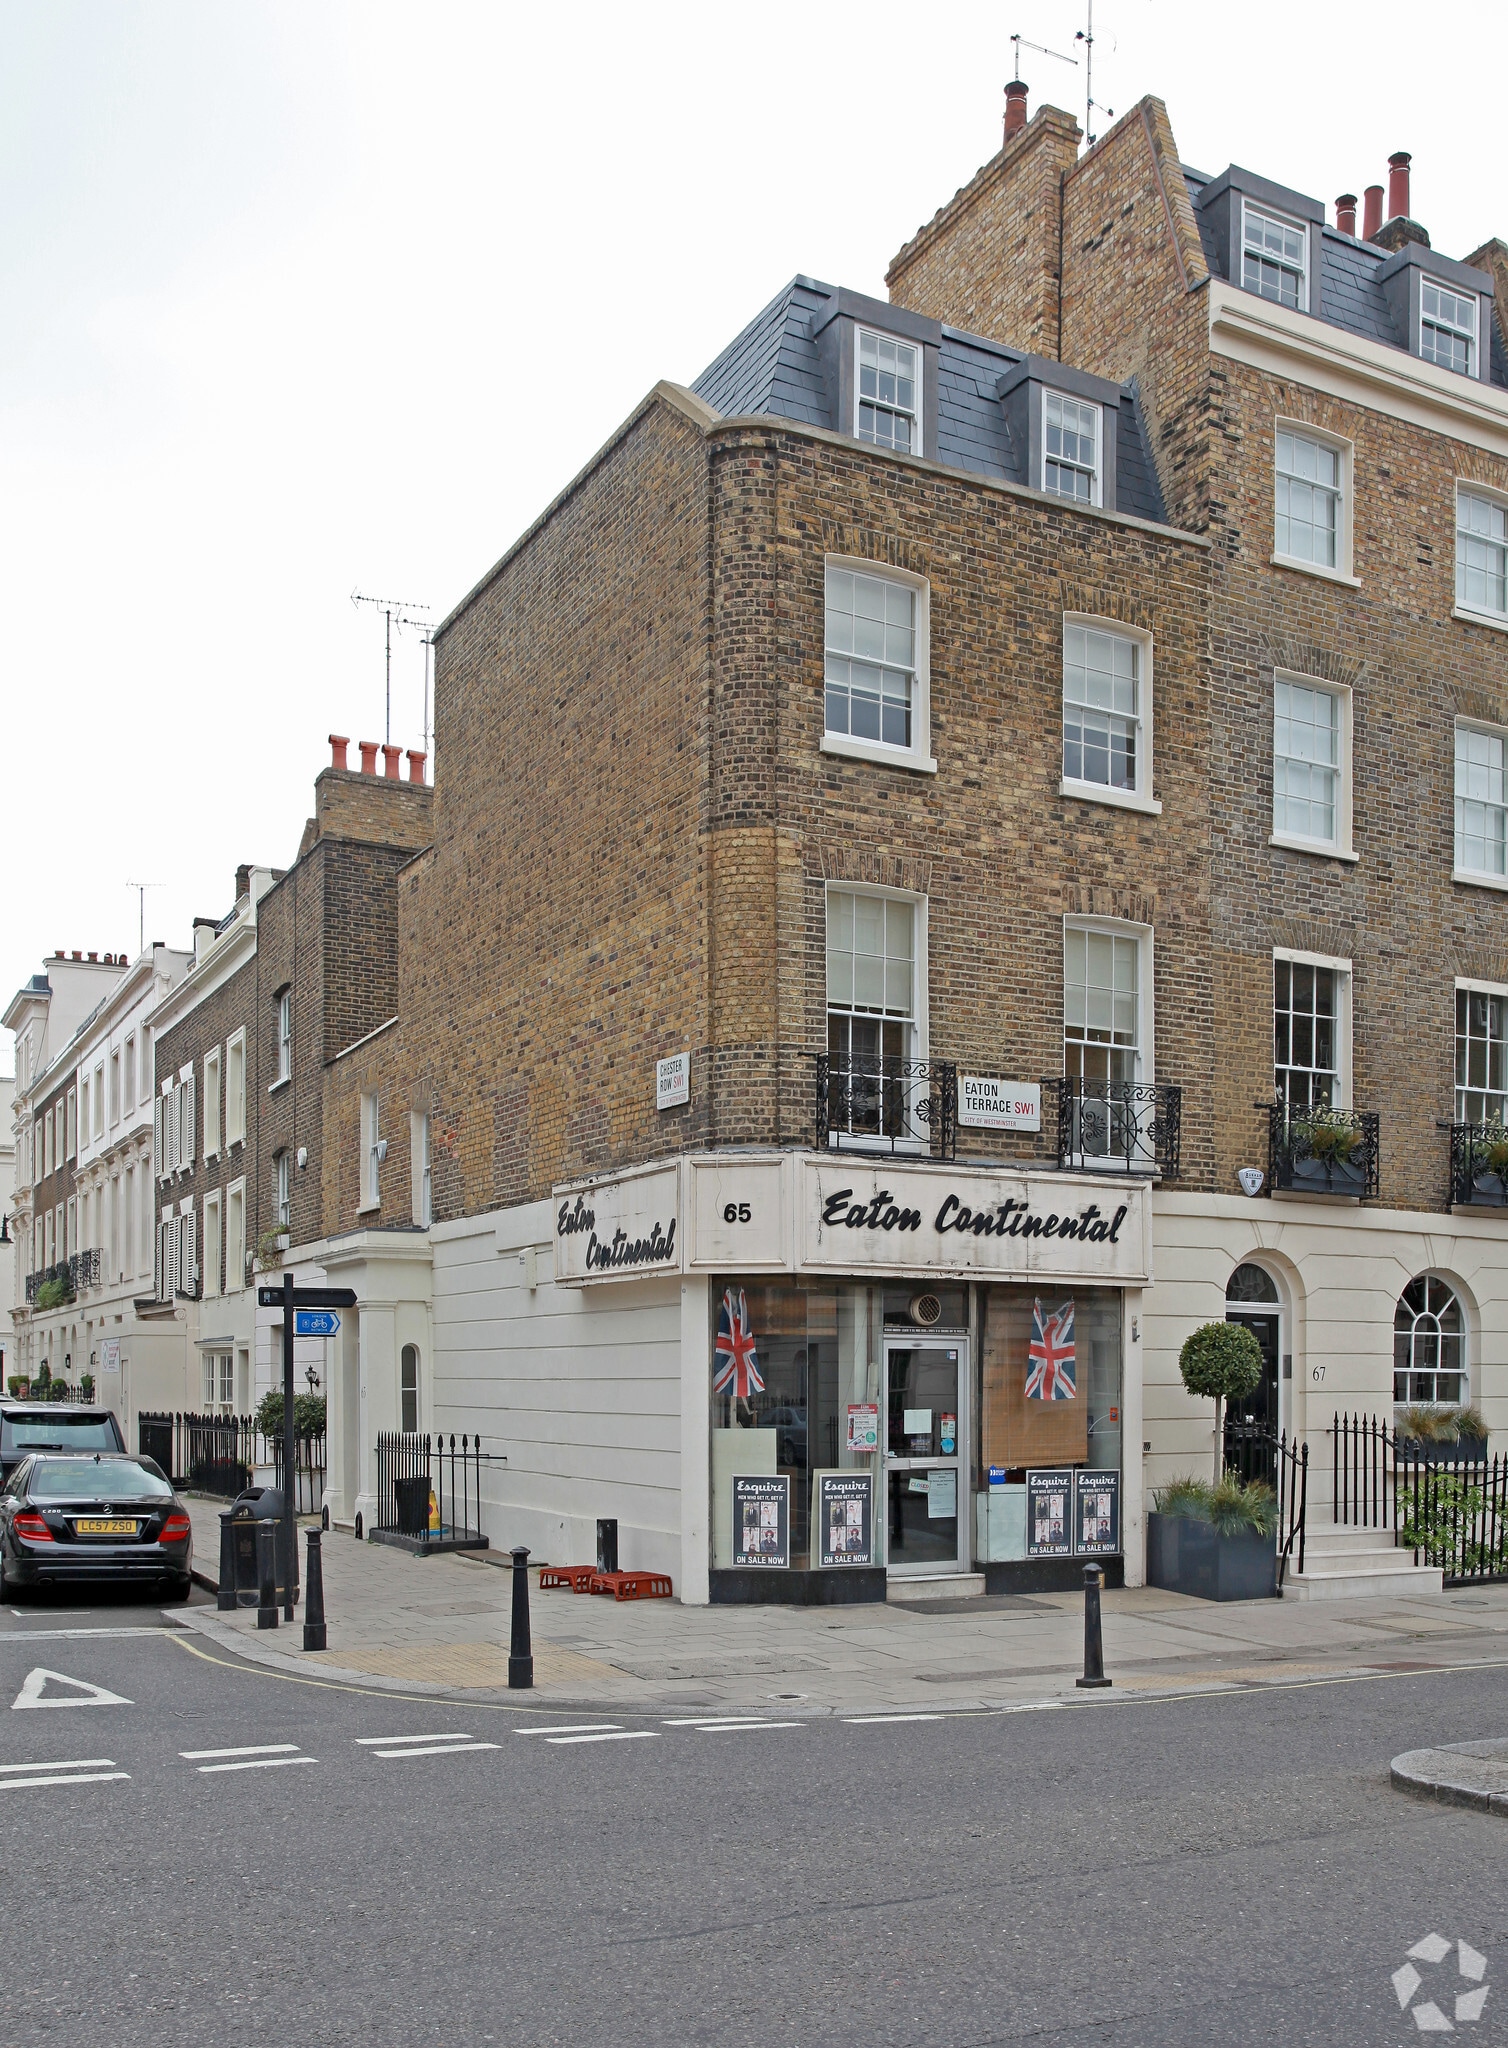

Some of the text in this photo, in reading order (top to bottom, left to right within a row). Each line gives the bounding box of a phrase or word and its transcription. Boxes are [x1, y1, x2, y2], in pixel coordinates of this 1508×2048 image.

[660, 1059, 682, 1077] CHESTER
[660, 1074, 684, 1092] ROW SW1
[965, 1082, 998, 1097] EATON
[965, 1097, 1034, 1115] TERRACE SW1
[964, 1116, 975, 1124] CITY
[983, 1118, 1017, 1127] WESTMINSTER
[557, 1195, 596, 1237] Eaton
[723, 1203, 751, 1224] 65
[822, 1188, 1128, 1244] Eaton Continental
[586, 1217, 677, 1270] Continental
[1312, 1365, 1326, 1381] 67
[737, 1481, 785, 1494] Esquire
[824, 1480, 869, 1493] Esquire
[1030, 1476, 1069, 1488] Esquire
[1078, 1475, 1116, 1488] Esquire
[81, 1521, 132, 1531] LC57 ZSO
[748, 1556, 766, 1564] SALE
[835, 1555, 852, 1563] SALE
[853, 1554, 868, 1562] NOW
